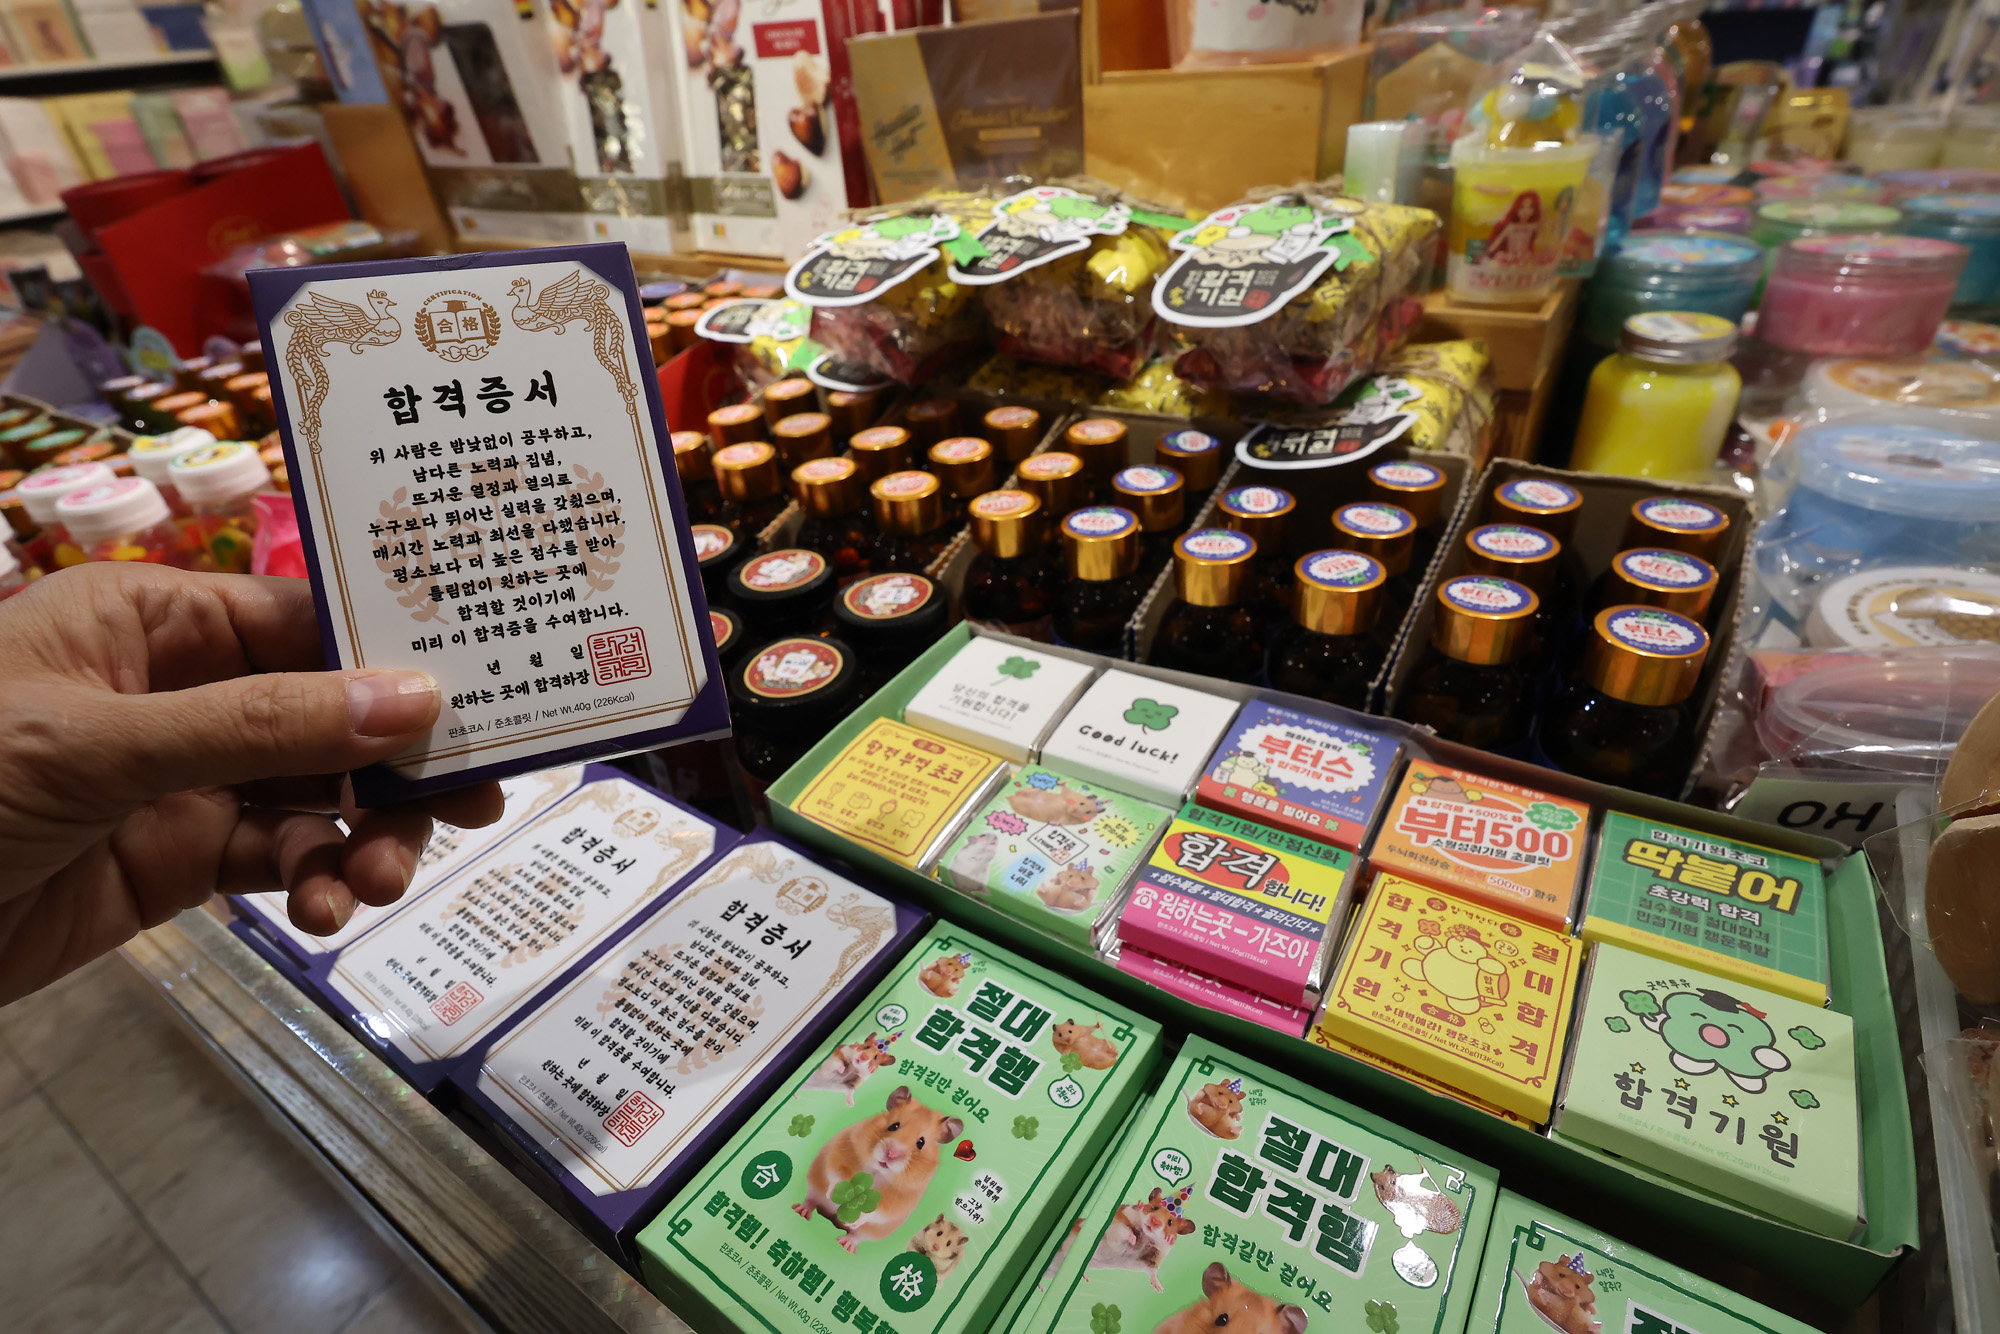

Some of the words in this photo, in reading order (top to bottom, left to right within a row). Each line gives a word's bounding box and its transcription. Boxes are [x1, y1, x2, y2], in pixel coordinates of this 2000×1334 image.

[424, 290, 482, 306] CERTIFICATION
[383, 369, 557, 425] 합격증서
[369, 447, 385, 464] 위
[393, 441, 442, 460] 사람은
[449, 431, 513, 454] 밤낮없이
[520, 425, 591, 445] 공부하고,
[412, 462, 461, 483] 남다른
[470, 454, 519, 473] 노력과
[525, 449, 561, 468] 집념,
[411, 486, 463, 505] 뜨거운
[470, 478, 518, 499] 열정과
[524, 473, 572, 491] 열의로
[367, 512, 437, 537] 누구보다
[445, 505, 493, 526] 뛰어난
[501, 497, 545, 518] 실력을
[553, 488, 620, 511] 갖췄으며,
[372, 539, 423, 560] 매시간
[432, 530, 482, 551] 노력과
[489, 522, 535, 542] 최선을
[542, 510, 626, 534] 다했습니다.
[392, 557, 461, 583] 평소보다
[468, 553, 483, 569] 더
[491, 548, 522, 567] 높은
[529, 539, 578, 561] 점수를
[584, 533, 615, 552] 받아
[428, 576, 492, 602] 틀림없이
[500, 569, 548, 589] 원하는
[555, 561, 587, 581] 곳에
[456, 598, 504, 621] 합격할
[512, 586, 575, 612] 것이기에
[411, 633, 443, 652] 미리
[451, 629, 466, 645] 이
[473, 617, 537, 642] 합격증을
[545, 602, 629, 629] 수여합니다.
[486, 659, 501, 675] 년
[529, 651, 543, 667] 월
[570, 643, 584, 659] 일
[447, 723, 484, 739] 판초코A
[494, 712, 531, 729] 준초콜릿
[541, 708, 557, 718] Net
[592, 691, 635, 709] (226Kcal)
[450, 689, 494, 709] 원하는
[499, 680, 530, 700] 곳에
[1078, 725, 1125, 746] Good
[1130, 740, 1178, 763] luck!
[1258, 734, 1353, 778] 부터스
[1399, 805, 1572, 864] 부터500
[1178, 833, 1276, 895] 합격
[1625, 838, 1802, 915] 딱붙어
[1489, 876, 1530, 896] 500mg
[1649, 884, 1708, 910] 초강력
[1718, 903, 1759, 925] 합격
[719, 900, 811, 959] 합격증서
[1209, 939, 1220, 947] Net
[966, 981, 1051, 1042] 절대
[573, 1015, 593, 1031] 미리
[590, 1028, 602, 1038] 이
[597, 1034, 633, 1063] 합격증을
[632, 1035, 670, 1064] 것이기에
[915, 1007, 1039, 1095] 합격햄
[1434, 1035, 1447, 1045] Net
[897, 1058, 952, 1094] 합격길만
[951, 1086, 989, 1123] 걸어요
[751, 1162, 780, 1188] 合
[1259, 1116, 1363, 1198] 절대
[1213, 1154, 1370, 1274] 합격햄
[703, 1190, 770, 1250] 합격햄!
[767, 1238, 835, 1304] 축하햄!
[889, 1263, 923, 1301] 格
[1203, 1224, 1274, 1272] 합격길만
[1279, 1262, 1332, 1313] 걸어요
[1596, 1268, 1615, 1280] 내맘
[1598, 1280, 1622, 1293] 알쥐?
[776, 1289, 789, 1307] Net
